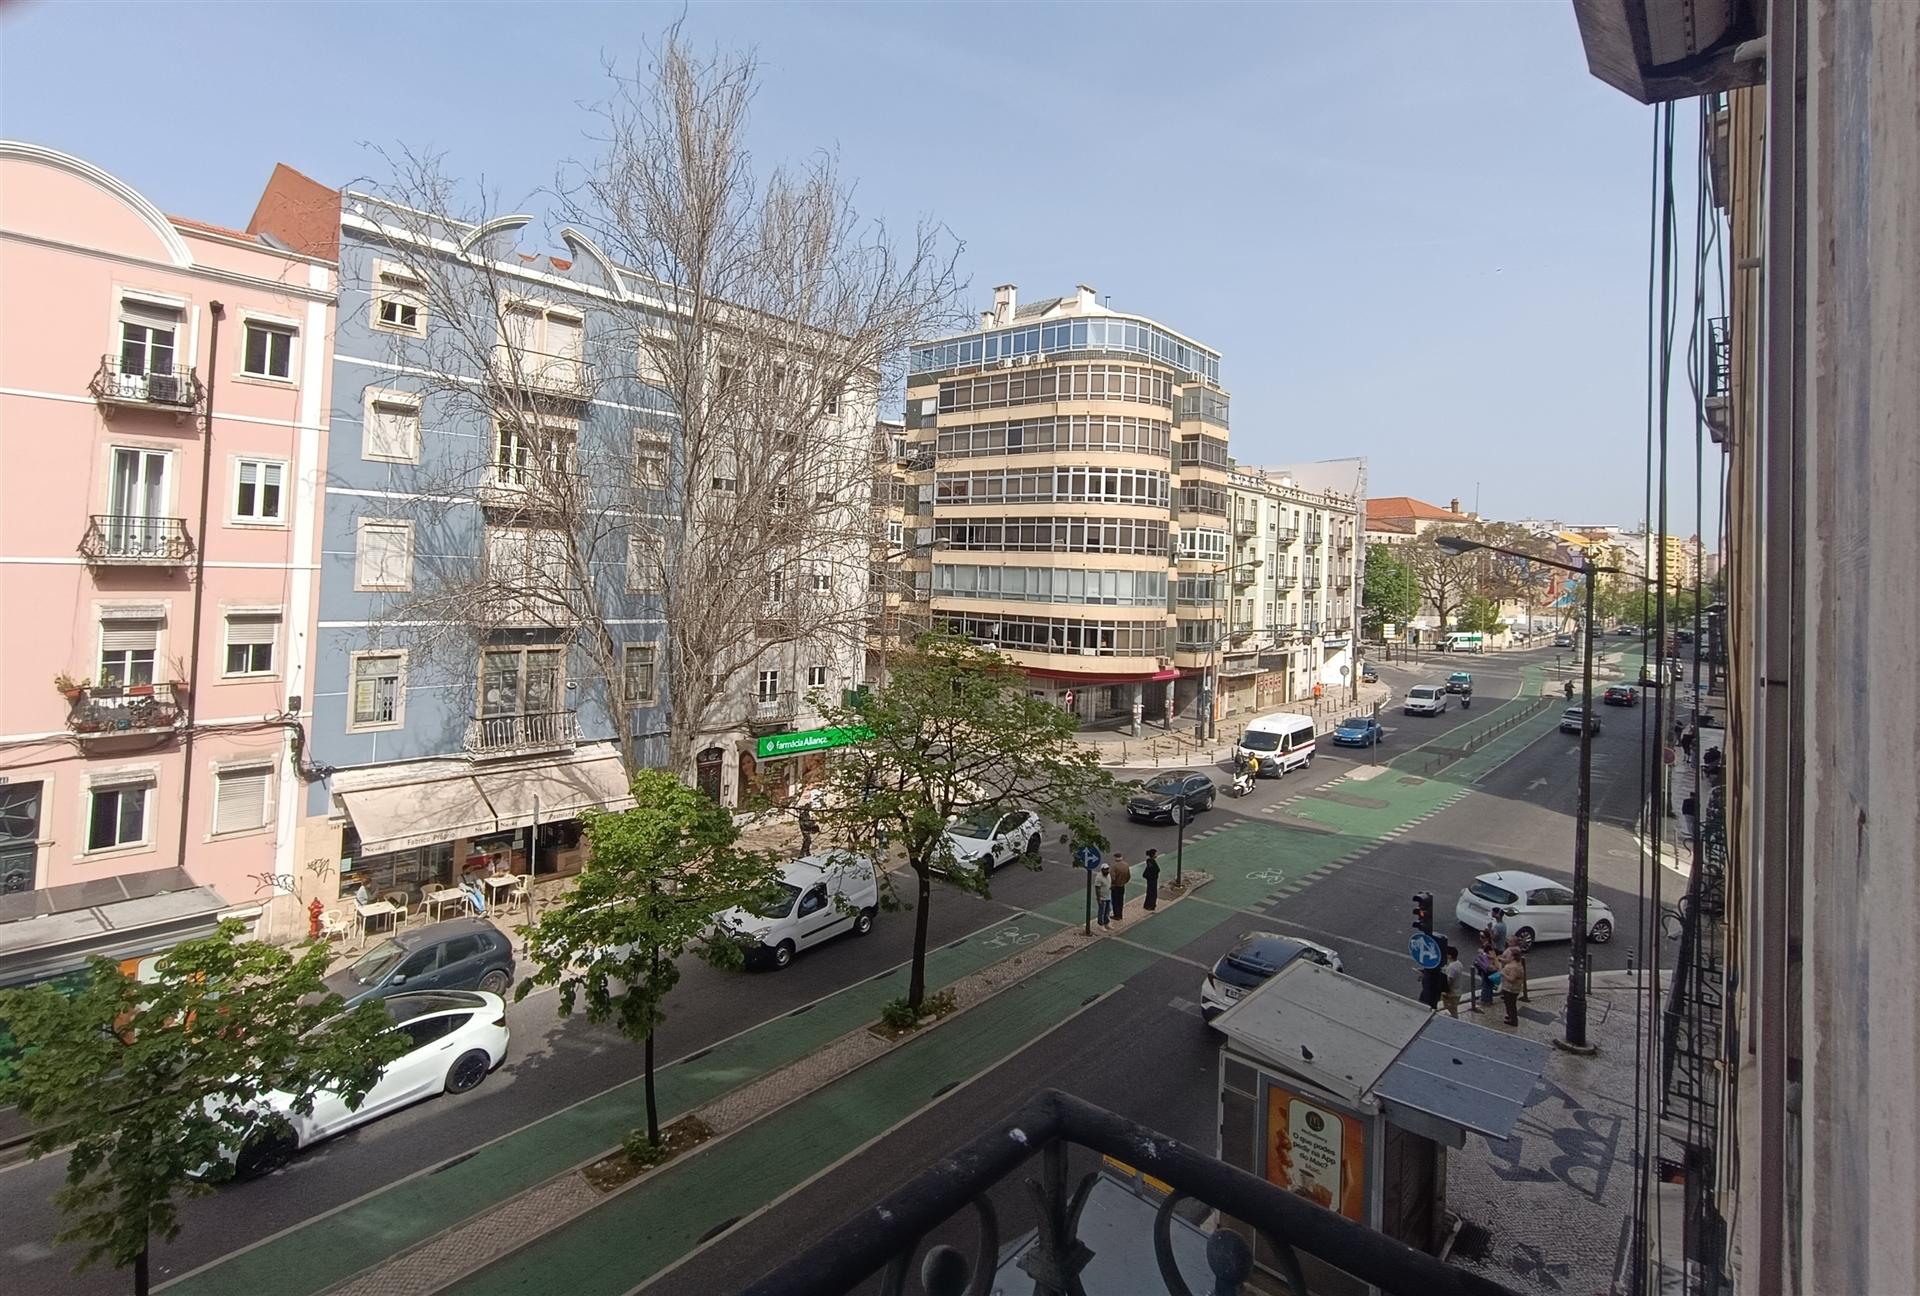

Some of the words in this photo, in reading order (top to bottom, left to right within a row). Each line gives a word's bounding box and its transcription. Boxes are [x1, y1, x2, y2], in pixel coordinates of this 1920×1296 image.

[1300, 1136, 1312, 1145] que
[1313, 1143, 1336, 1156] podes
[1321, 1153, 1336, 1165] App
